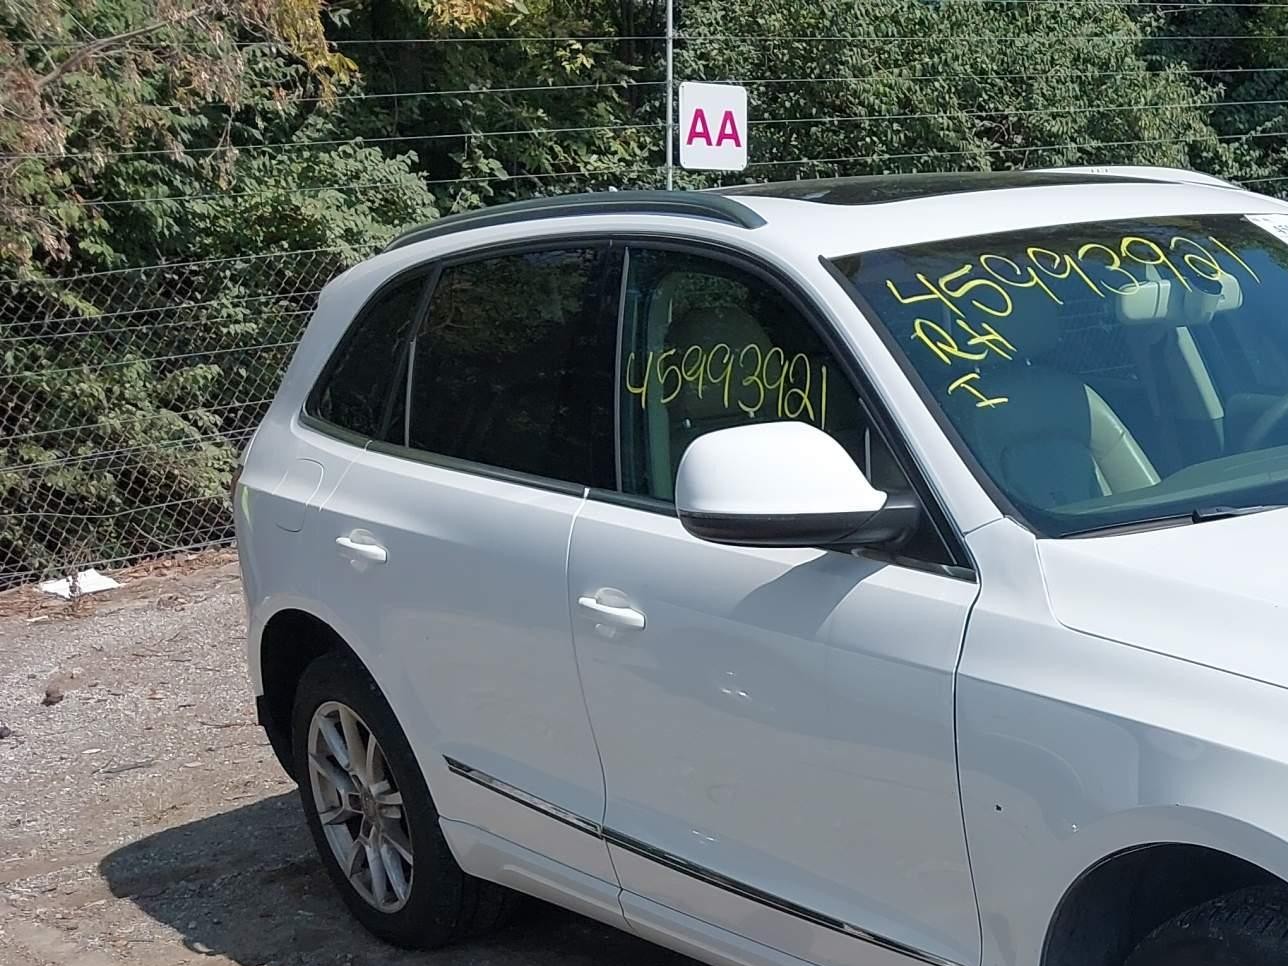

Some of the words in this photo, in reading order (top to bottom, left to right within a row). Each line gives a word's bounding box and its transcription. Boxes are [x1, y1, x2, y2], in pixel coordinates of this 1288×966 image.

[686, 108, 742, 148] AA
[886, 235, 1262, 318] 45993921
[626, 343, 827, 430] 45993921
